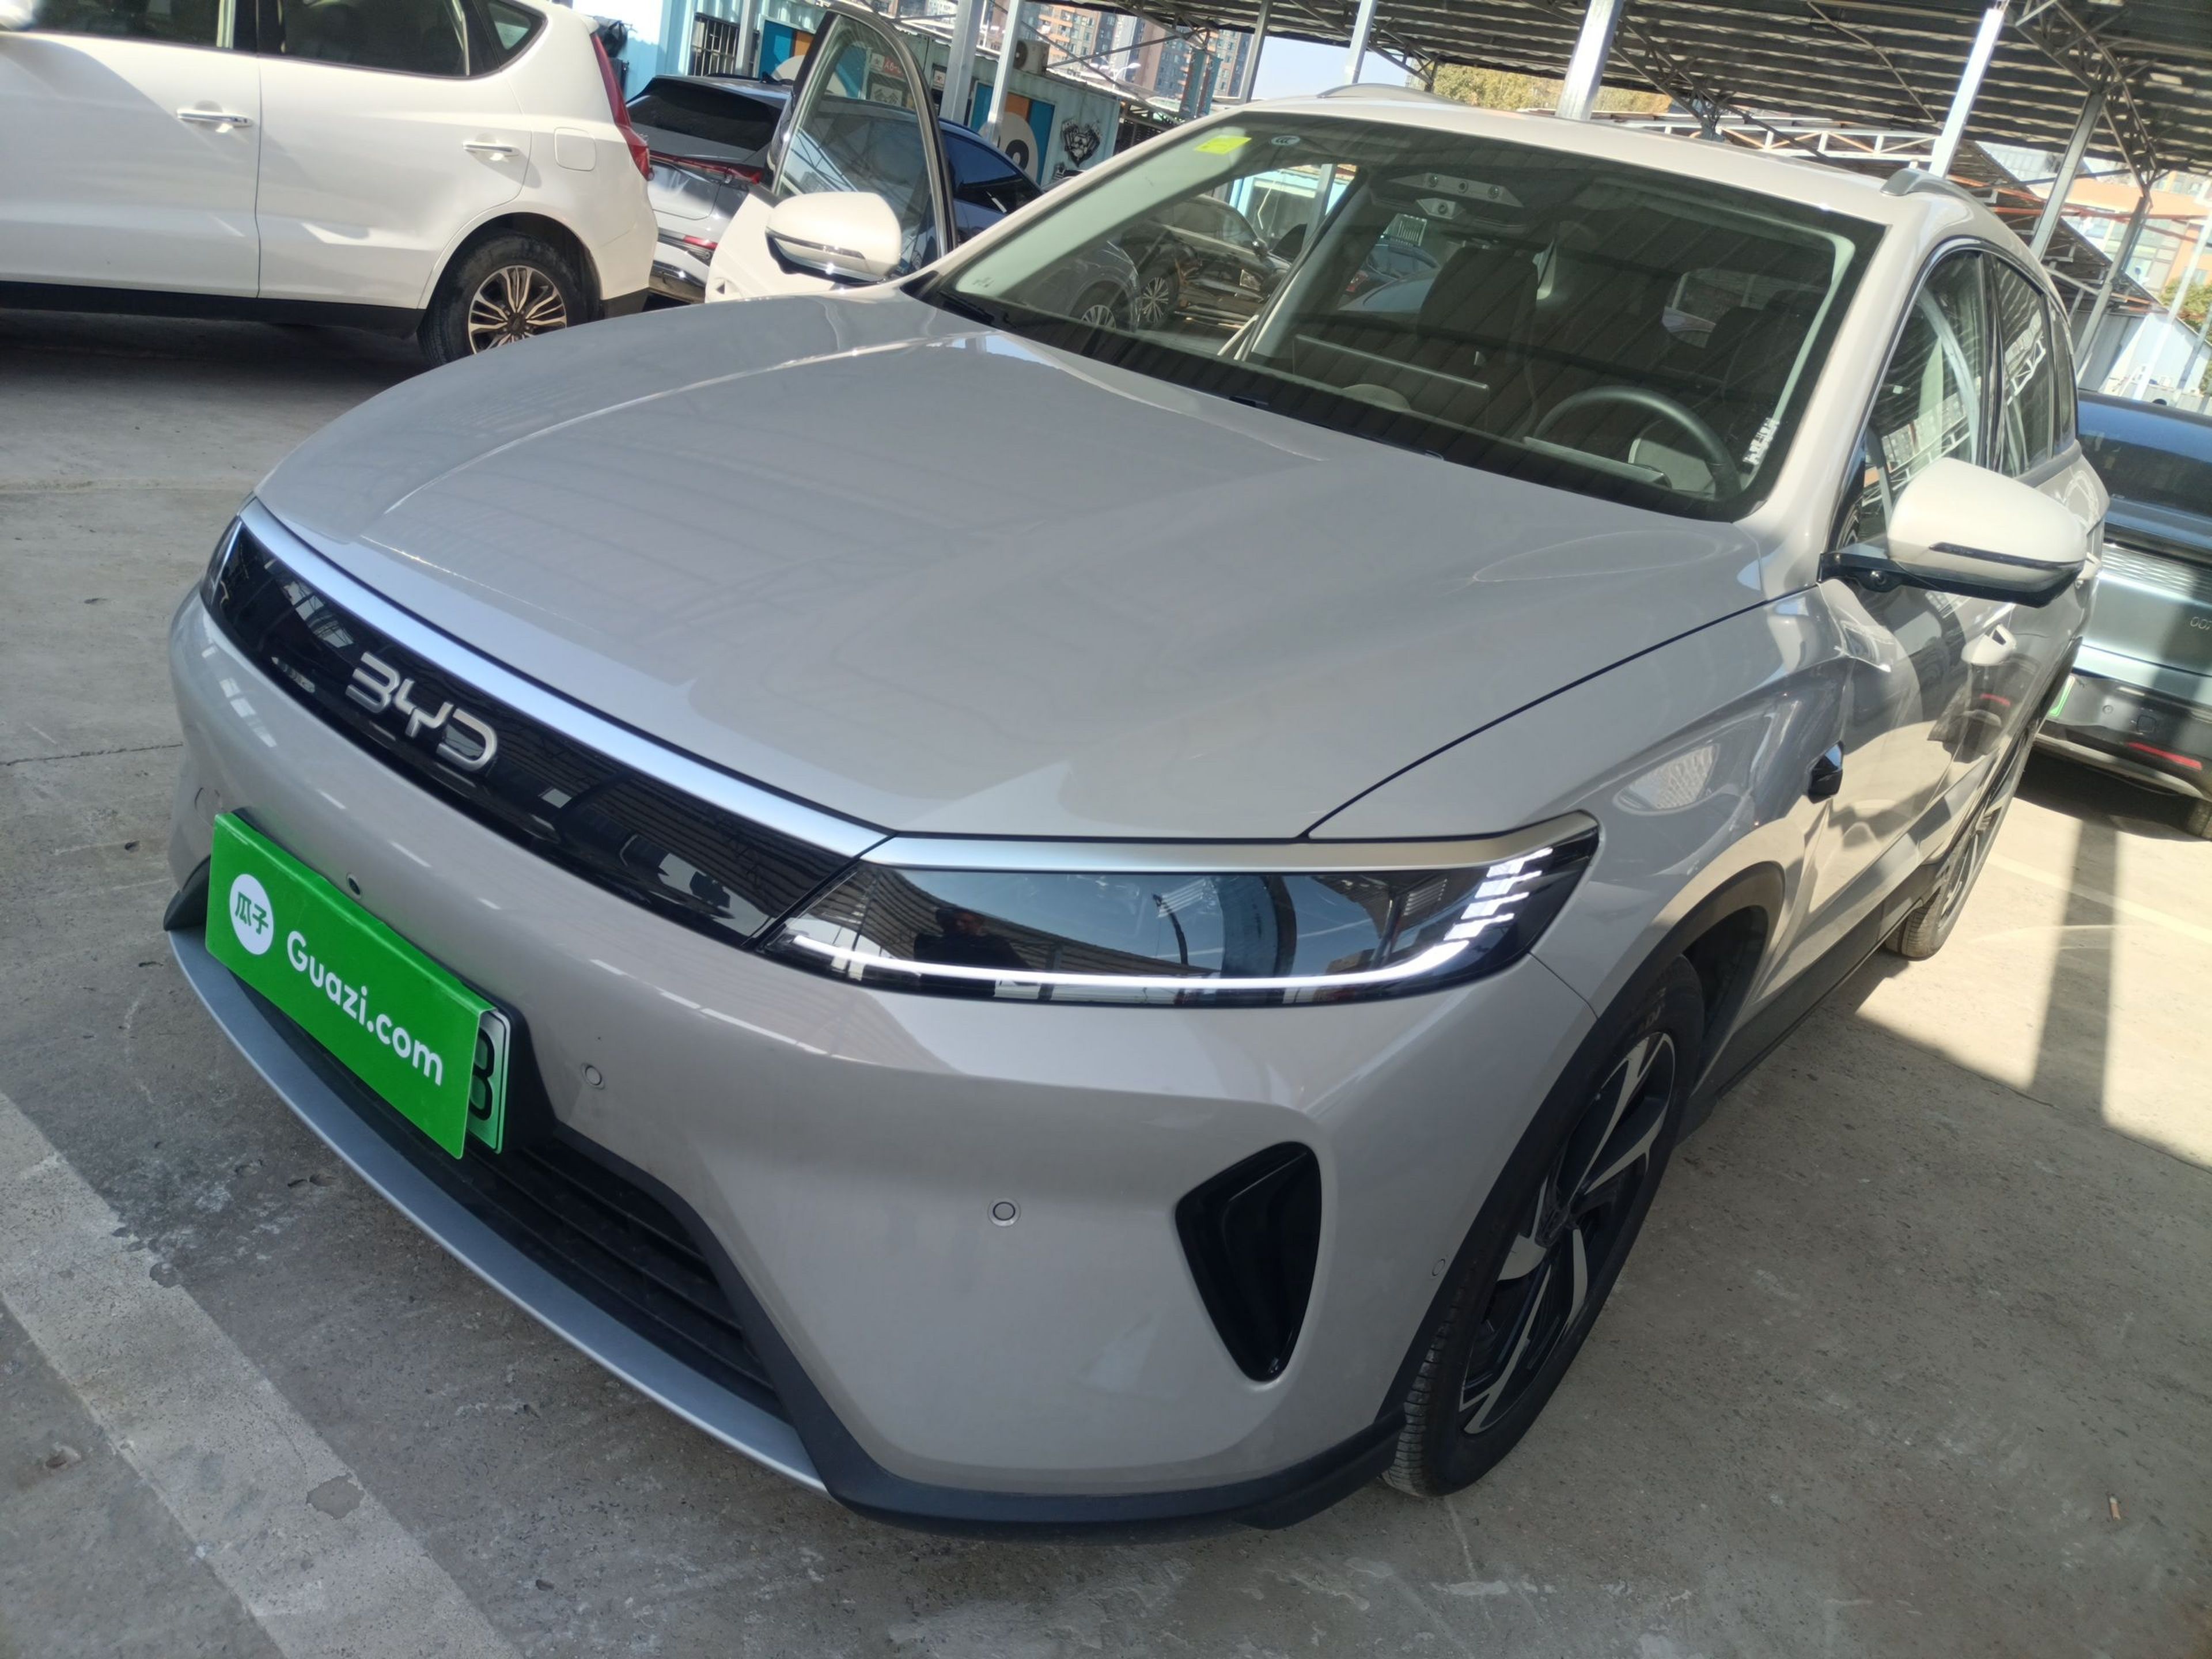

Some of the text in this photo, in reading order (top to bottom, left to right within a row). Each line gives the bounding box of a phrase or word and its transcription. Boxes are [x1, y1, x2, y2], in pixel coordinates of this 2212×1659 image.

[346, 651, 498, 771] BYD
[235, 891, 269, 935] 瓜子
[287, 930, 444, 1086] Guazi.com
